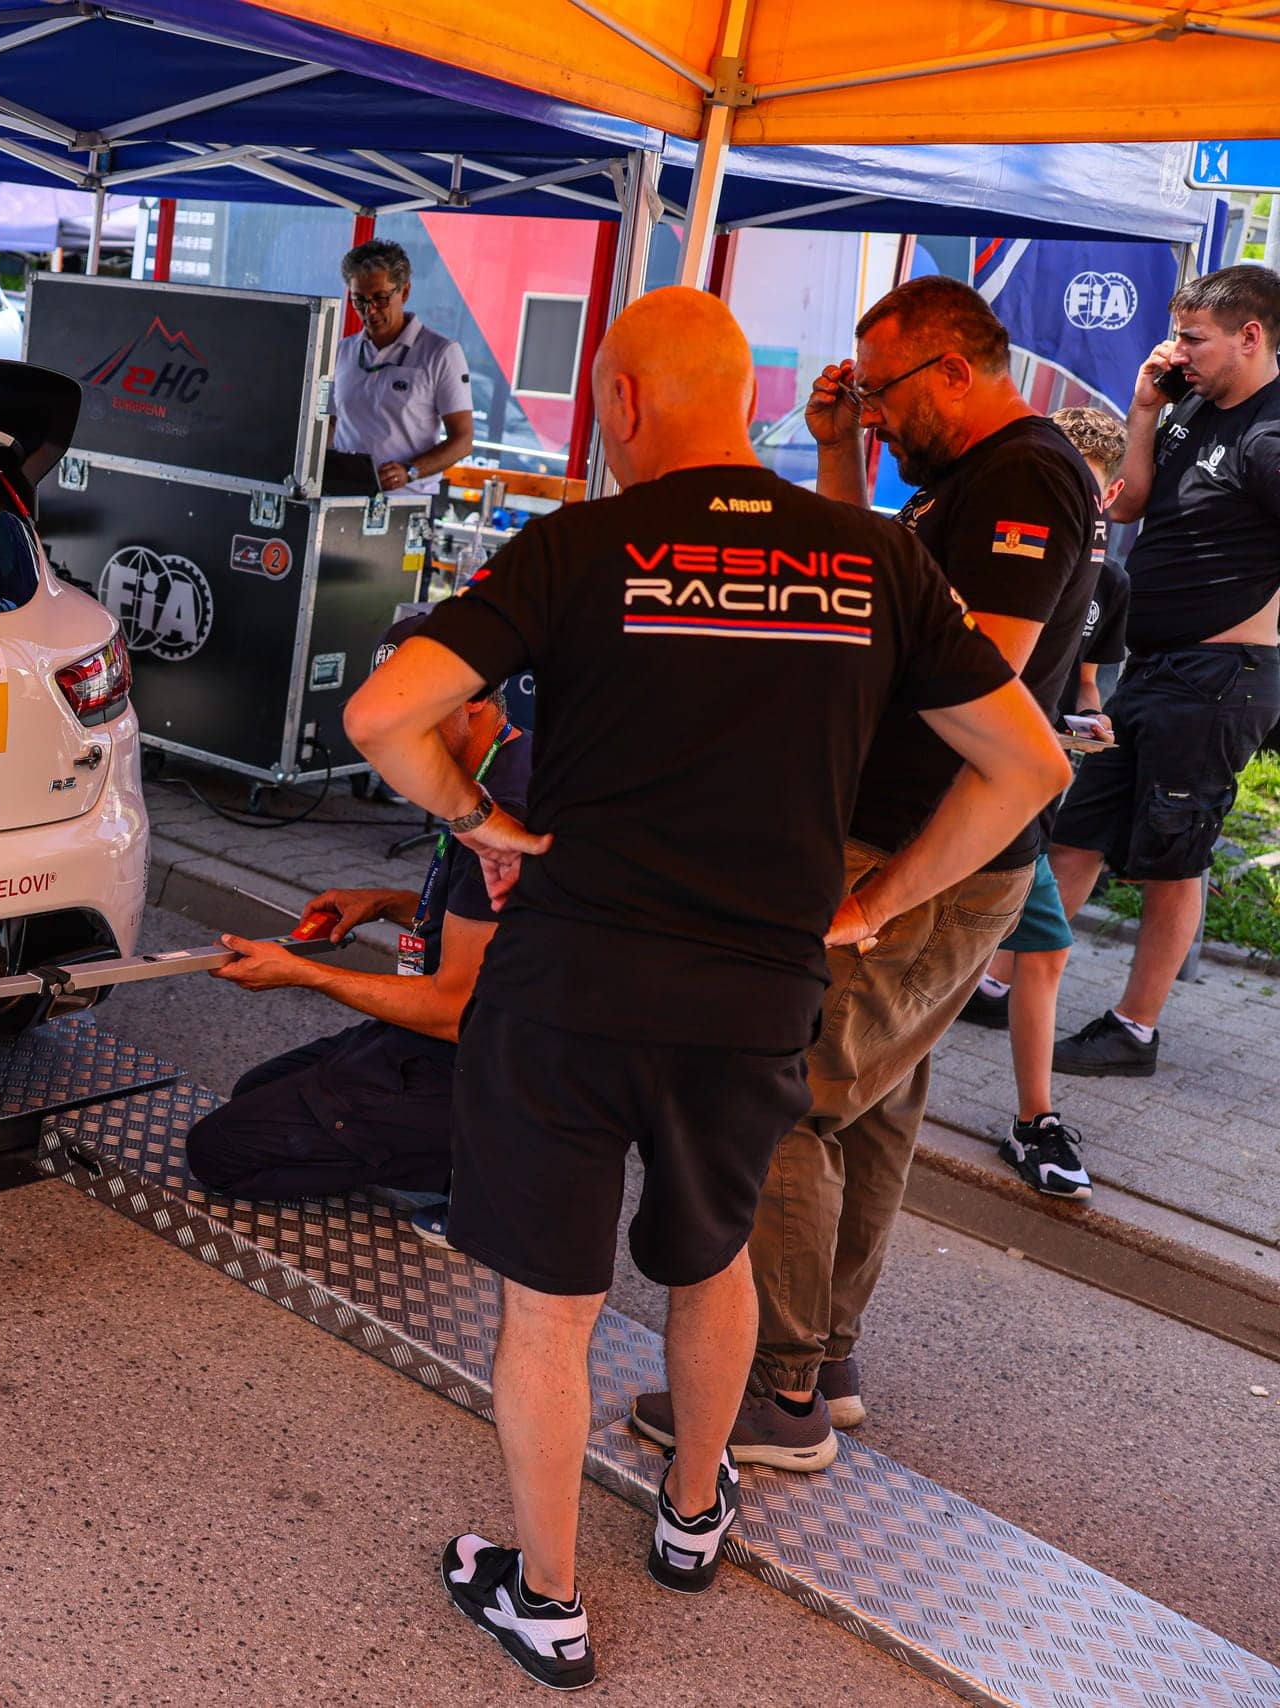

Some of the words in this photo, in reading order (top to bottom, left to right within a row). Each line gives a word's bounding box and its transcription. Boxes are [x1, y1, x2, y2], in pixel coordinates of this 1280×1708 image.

[111, 396, 168, 419] EUROPEAN
[624, 542, 874, 584] VESNIC
[623, 578, 873, 618] RACING
